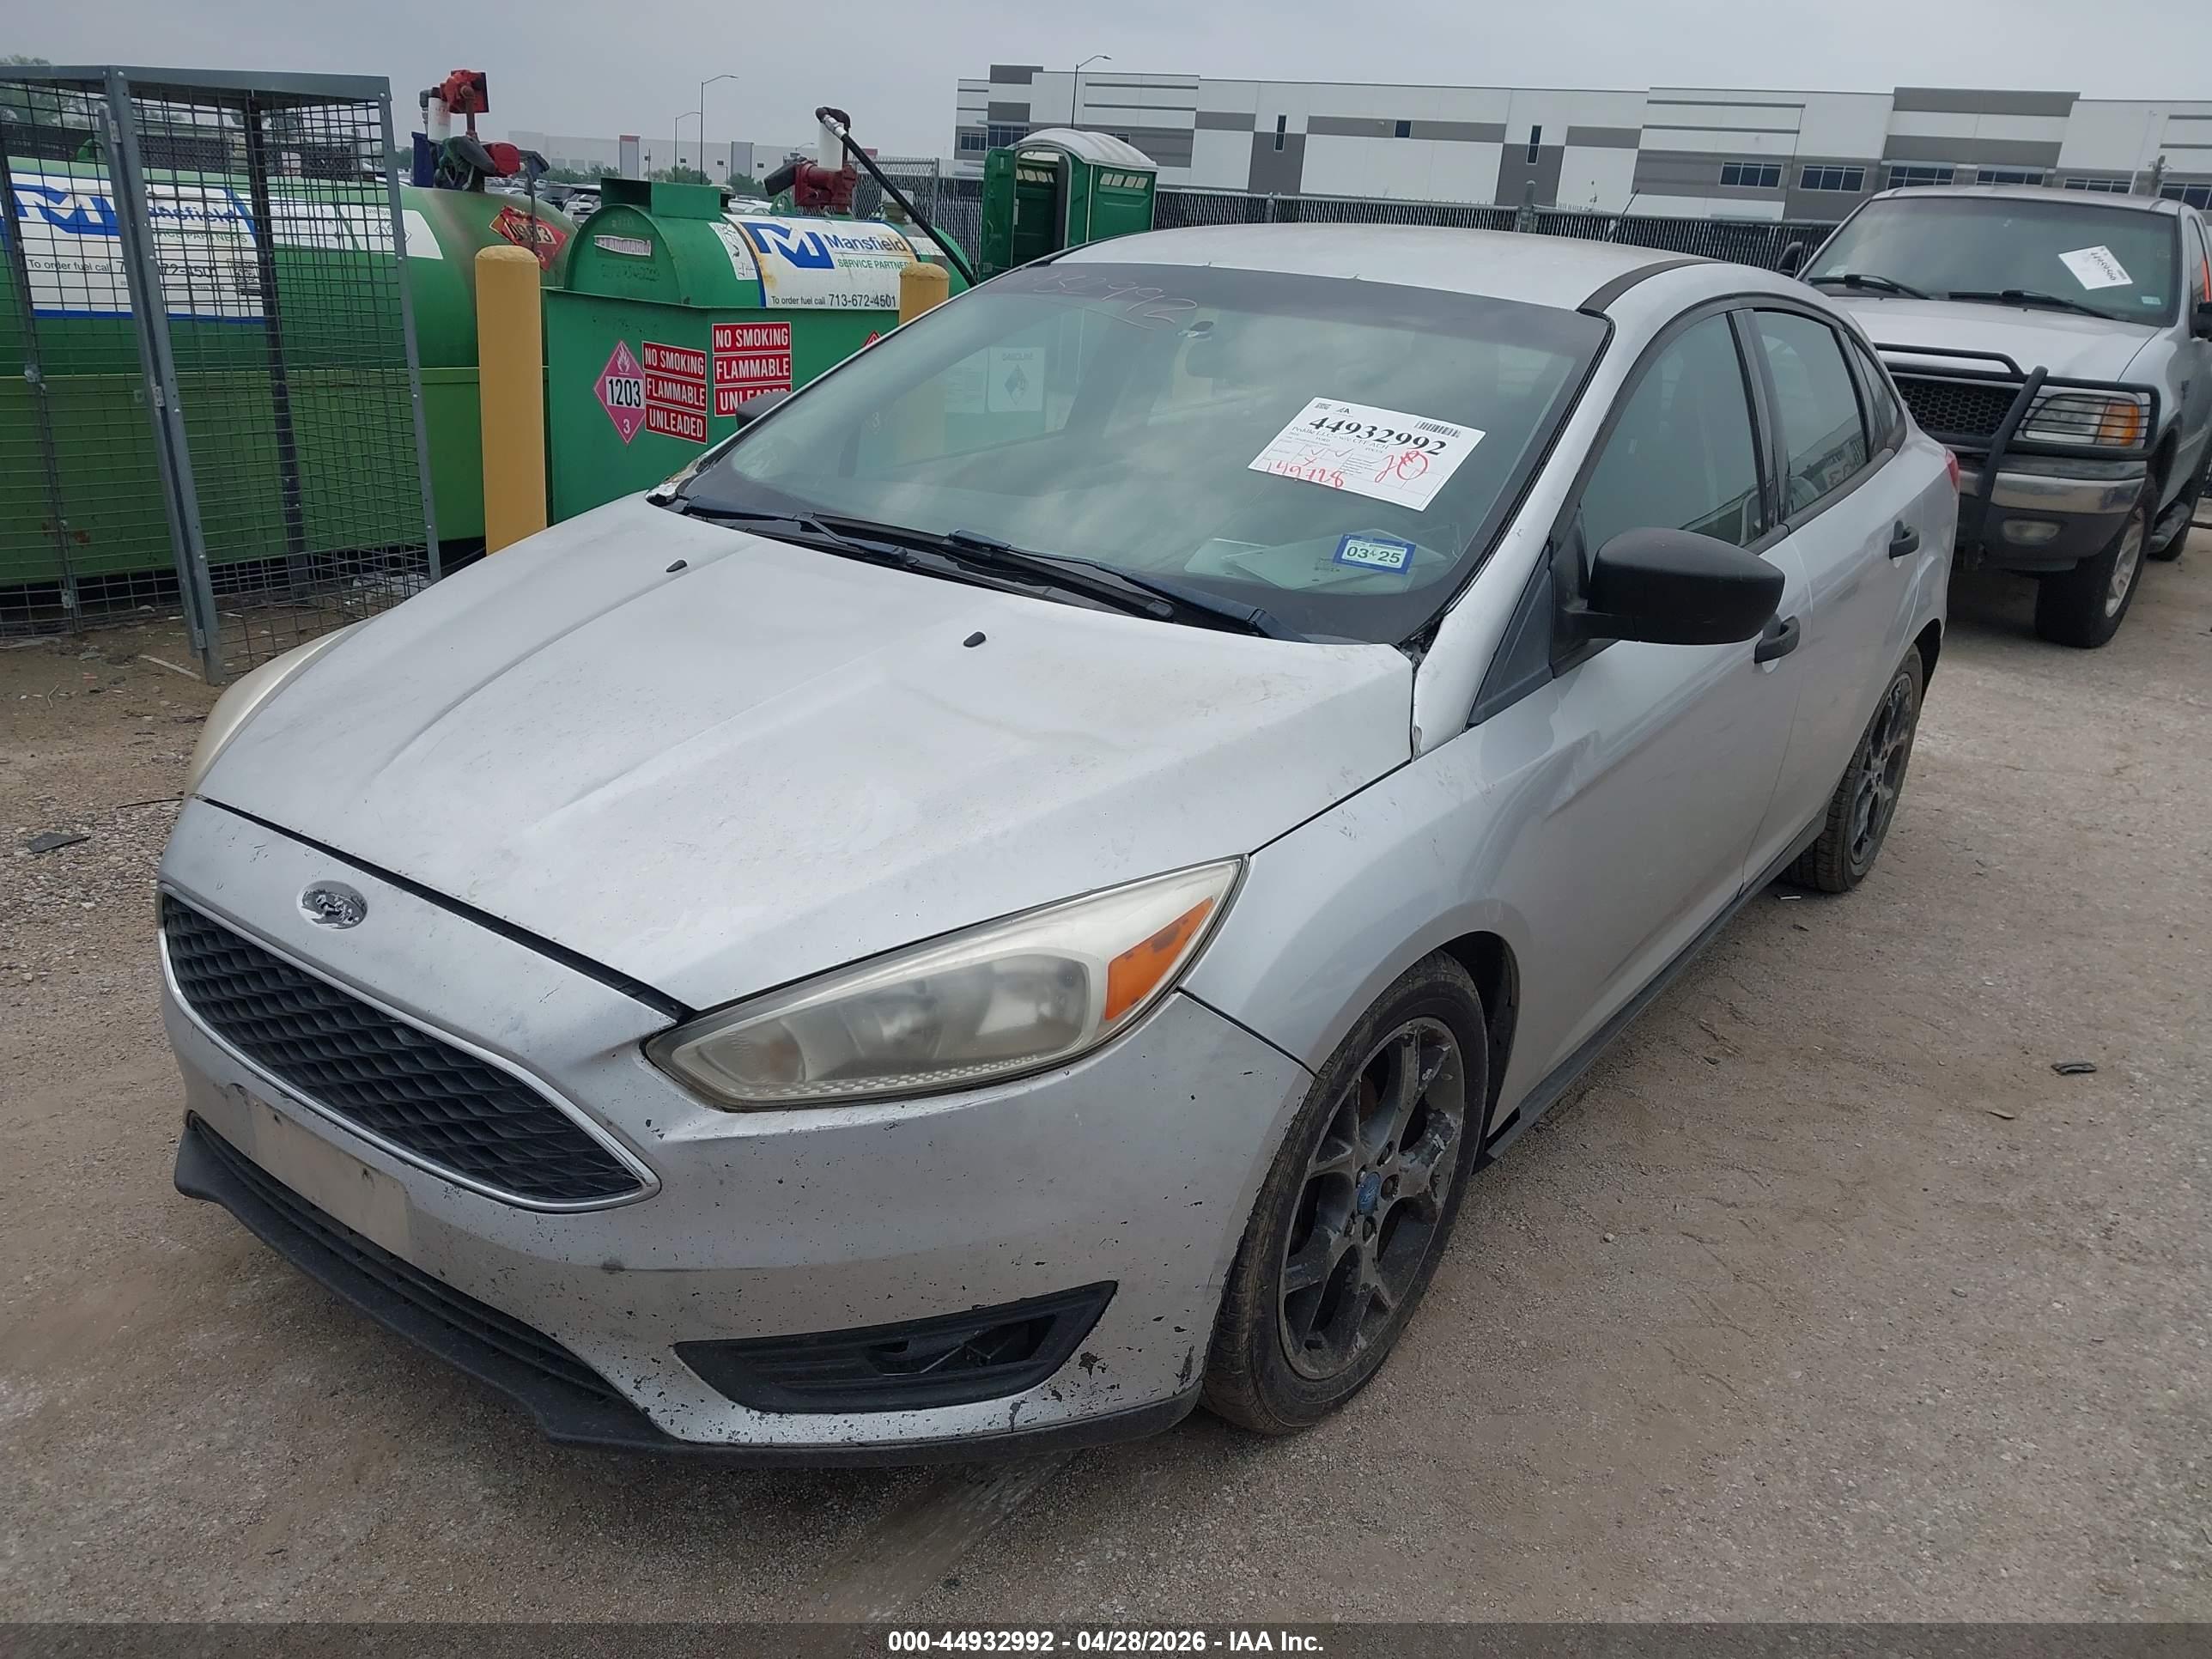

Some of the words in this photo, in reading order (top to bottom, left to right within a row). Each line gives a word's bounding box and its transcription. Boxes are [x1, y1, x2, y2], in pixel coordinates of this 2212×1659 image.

[823, 233, 908, 252] Mansfield
[27, 258, 41, 269] To
[44, 260, 71, 270] order
[74, 261, 93, 271] fuel
[837, 258, 873, 269] SERVICE
[771, 295, 781, 305] To
[781, 296, 799, 306] order
[800, 296, 814, 306] fuel
[814, 297, 826, 306] call
[829, 294, 896, 307] 713-672-4501
[715, 329, 731, 349] NO
[735, 327, 788, 348] SMOKING
[645, 347, 656, 366] NO
[660, 351, 704, 376] SMOKING
[716, 357, 790, 380] FLAMMABLE
[608, 378, 641, 408] 1203
[647, 377, 705, 408] FLAMMABLE
[623, 418, 631, 434] 3
[649, 408, 703, 438] UNLEADED
[1309, 416, 1447, 456] 44932992
[1346, 546, 1369, 559] 03
[1377, 550, 1401, 564] 25
